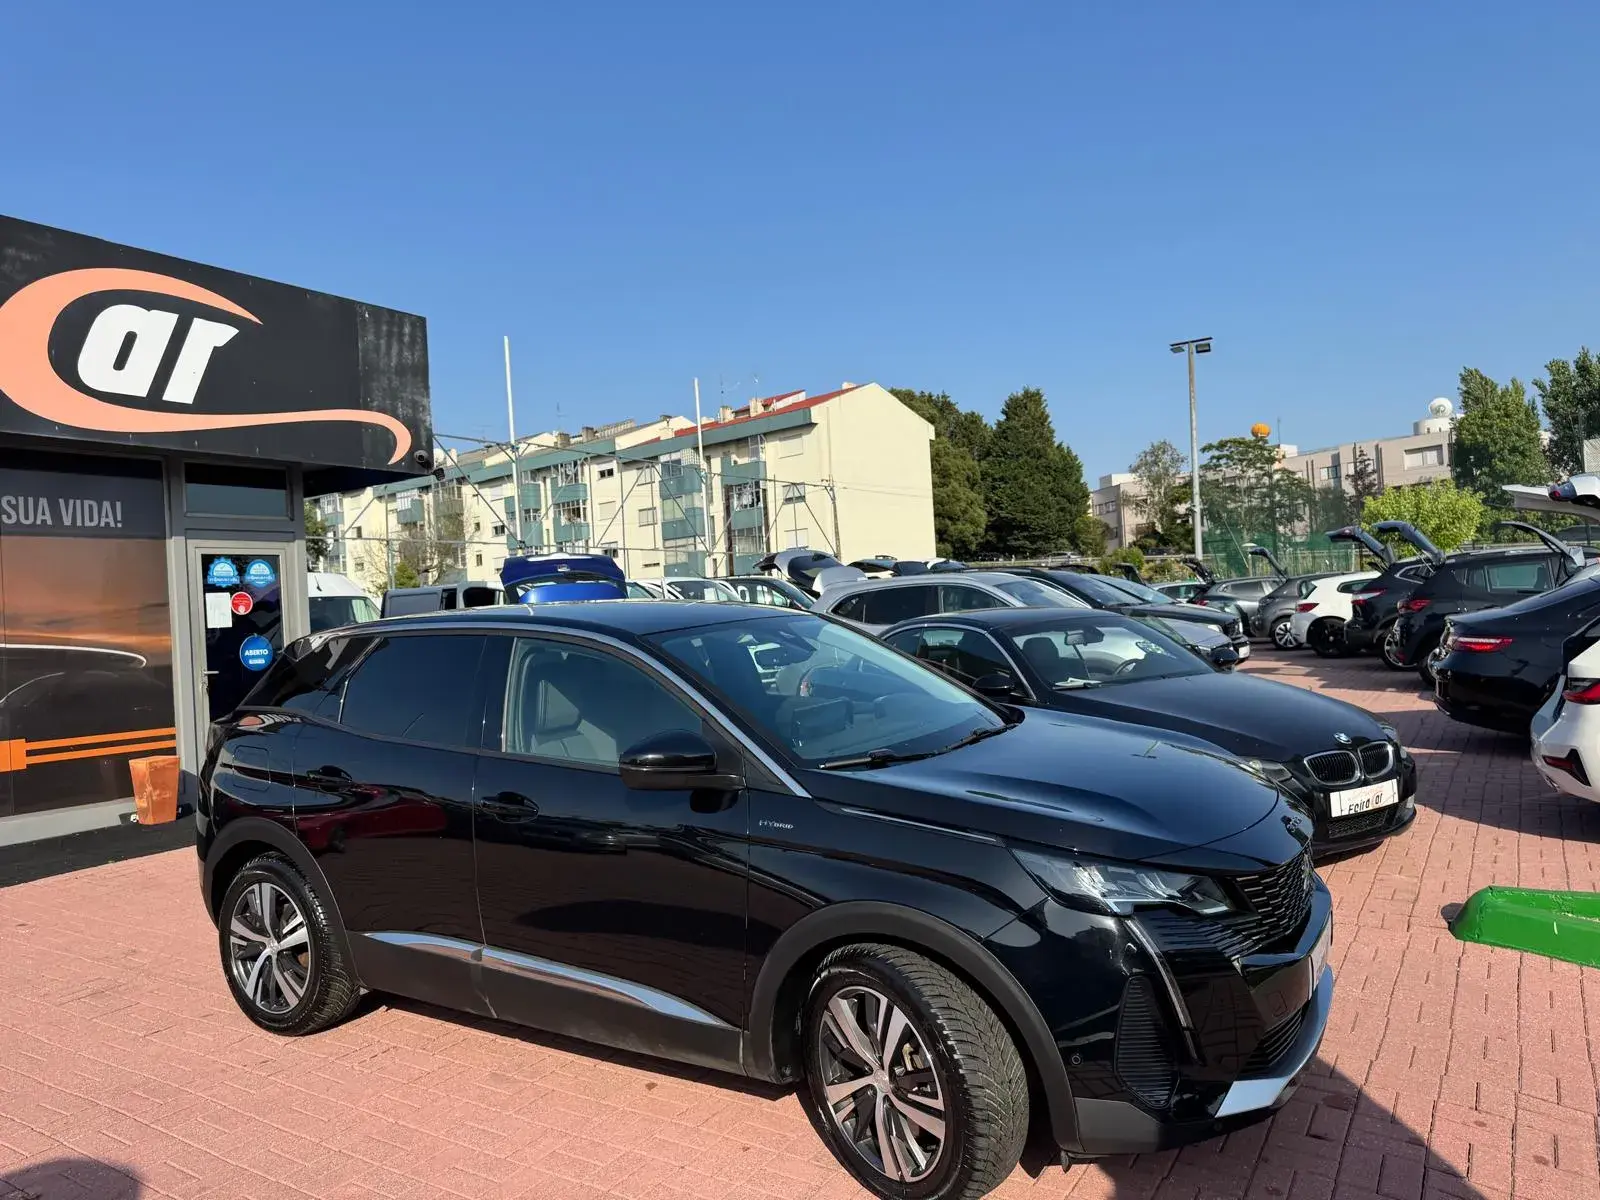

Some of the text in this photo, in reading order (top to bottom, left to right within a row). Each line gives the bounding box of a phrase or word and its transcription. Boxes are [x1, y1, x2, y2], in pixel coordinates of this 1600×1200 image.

[0, 495, 123, 528] SUA VIDA!
[758, 819, 794, 829] HYBRID
